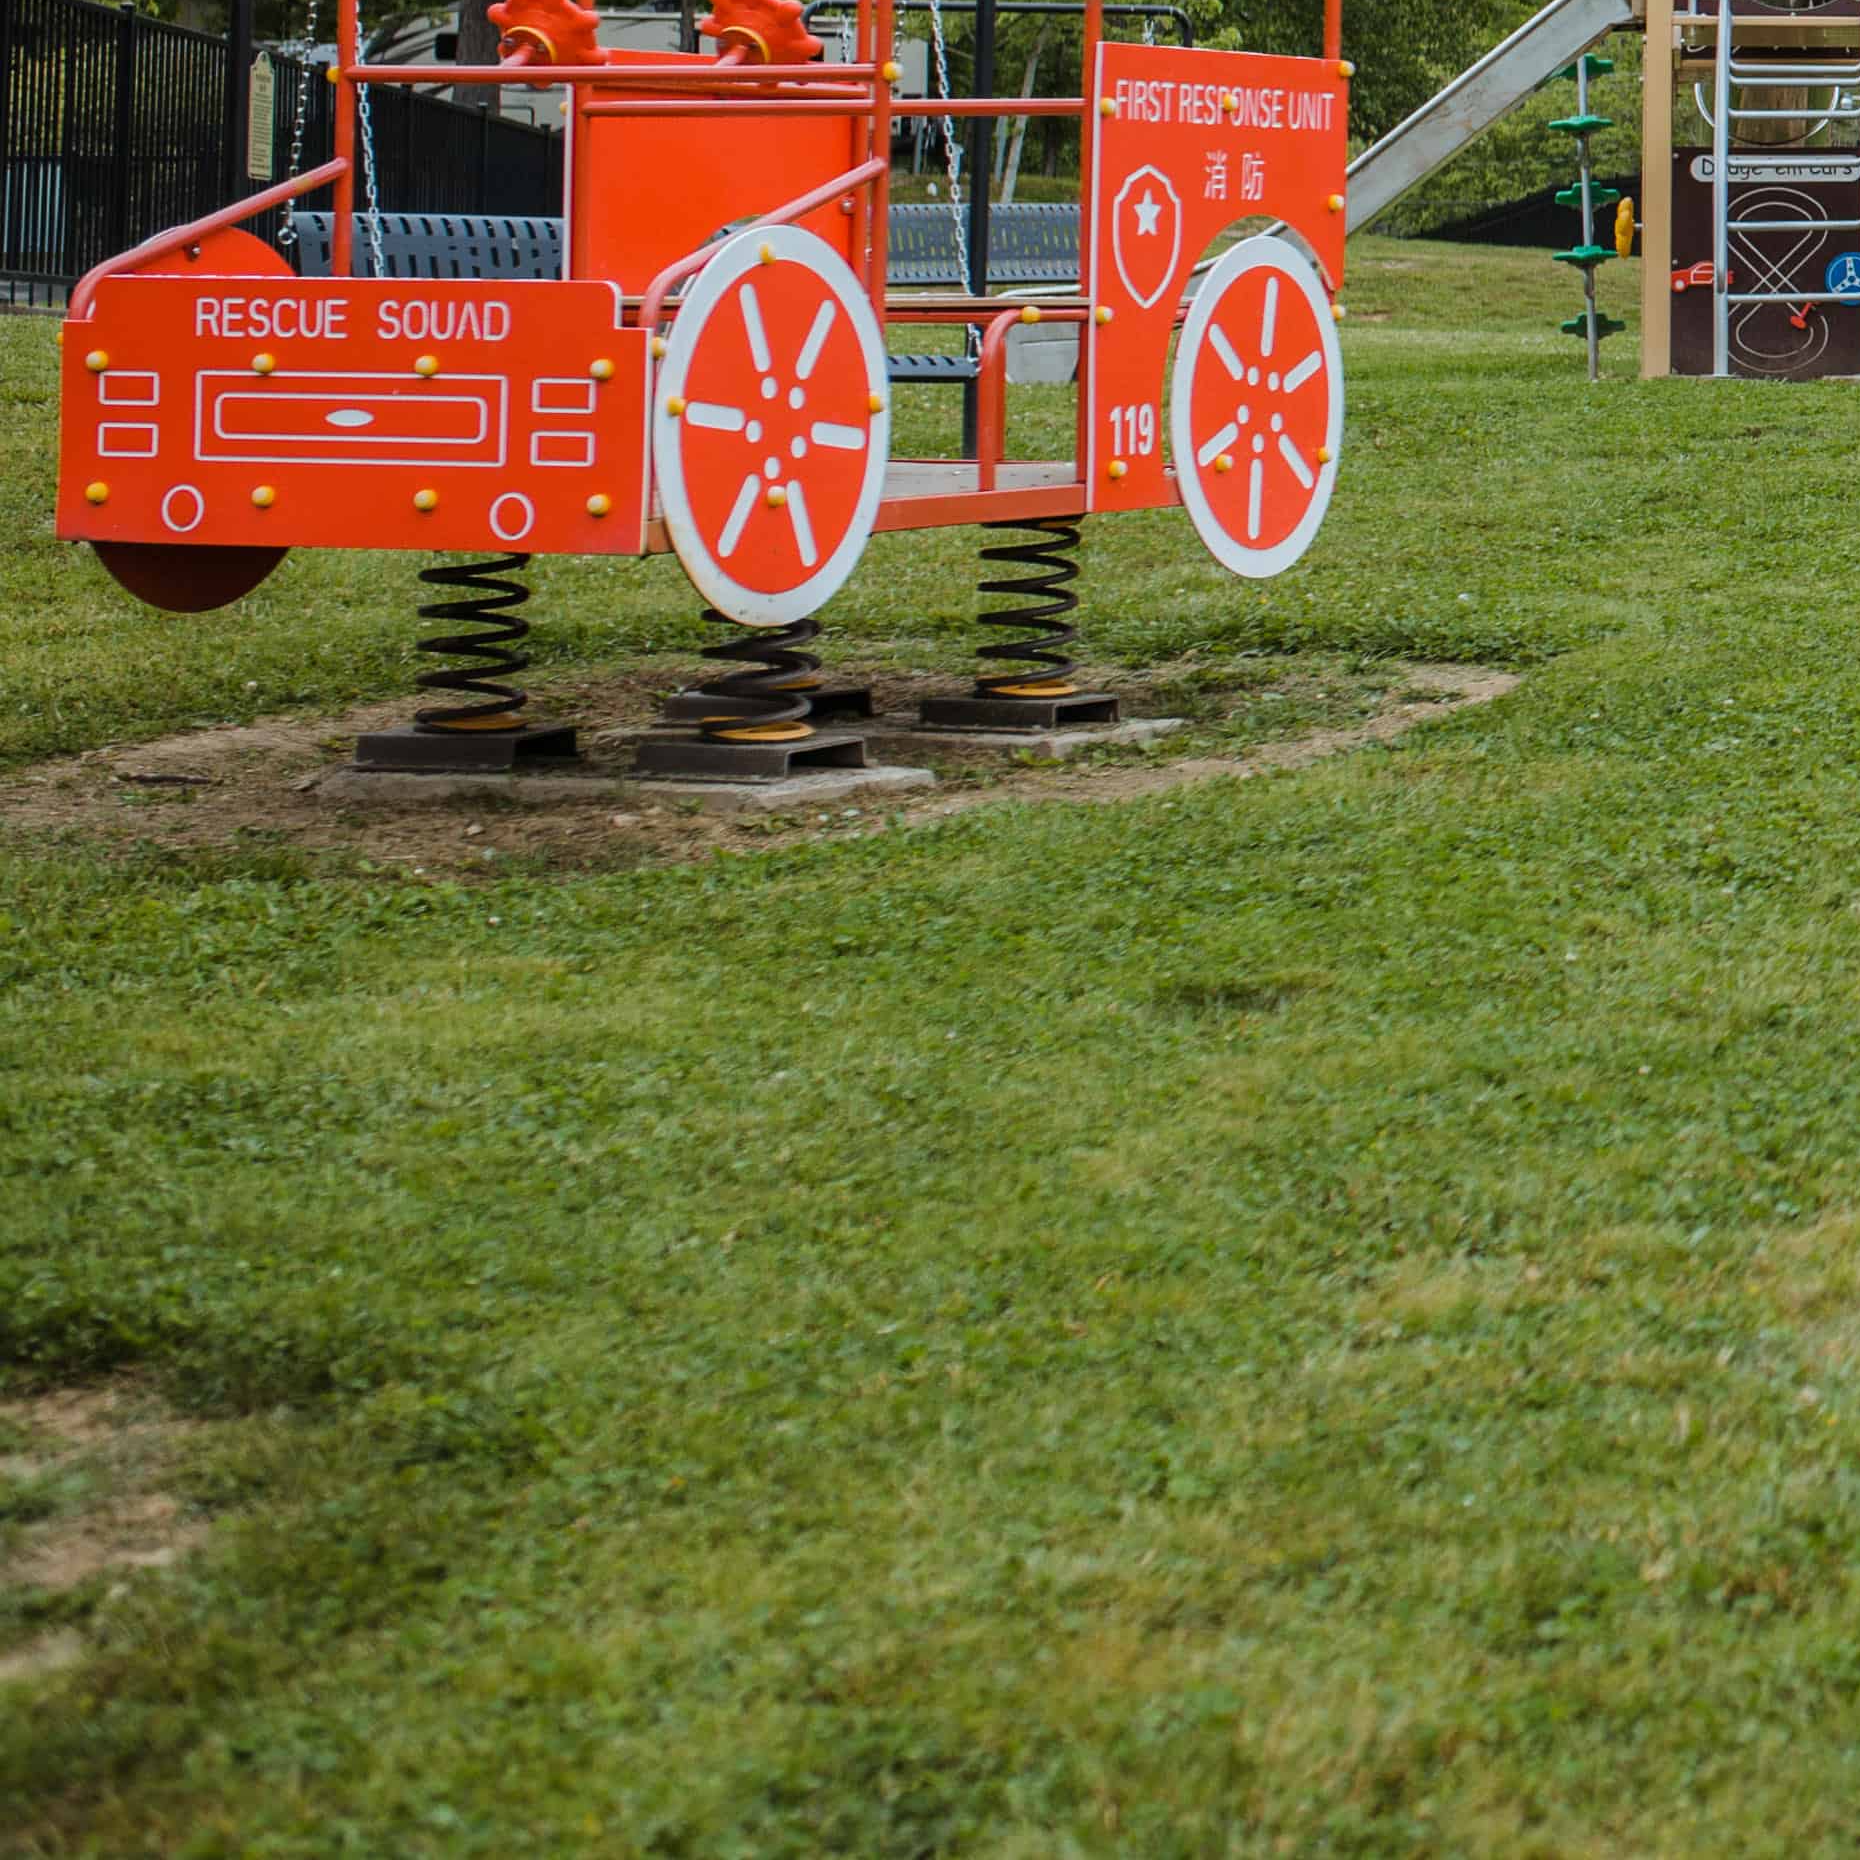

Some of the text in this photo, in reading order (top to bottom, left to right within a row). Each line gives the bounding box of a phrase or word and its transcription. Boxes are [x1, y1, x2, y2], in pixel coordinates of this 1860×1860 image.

[1115, 79, 1335, 130] FIRST RESPONSE UNIT
[1203, 149, 1265, 201] 消防
[195, 297, 349, 339] RESCUE
[1109, 403, 1155, 457] 119
